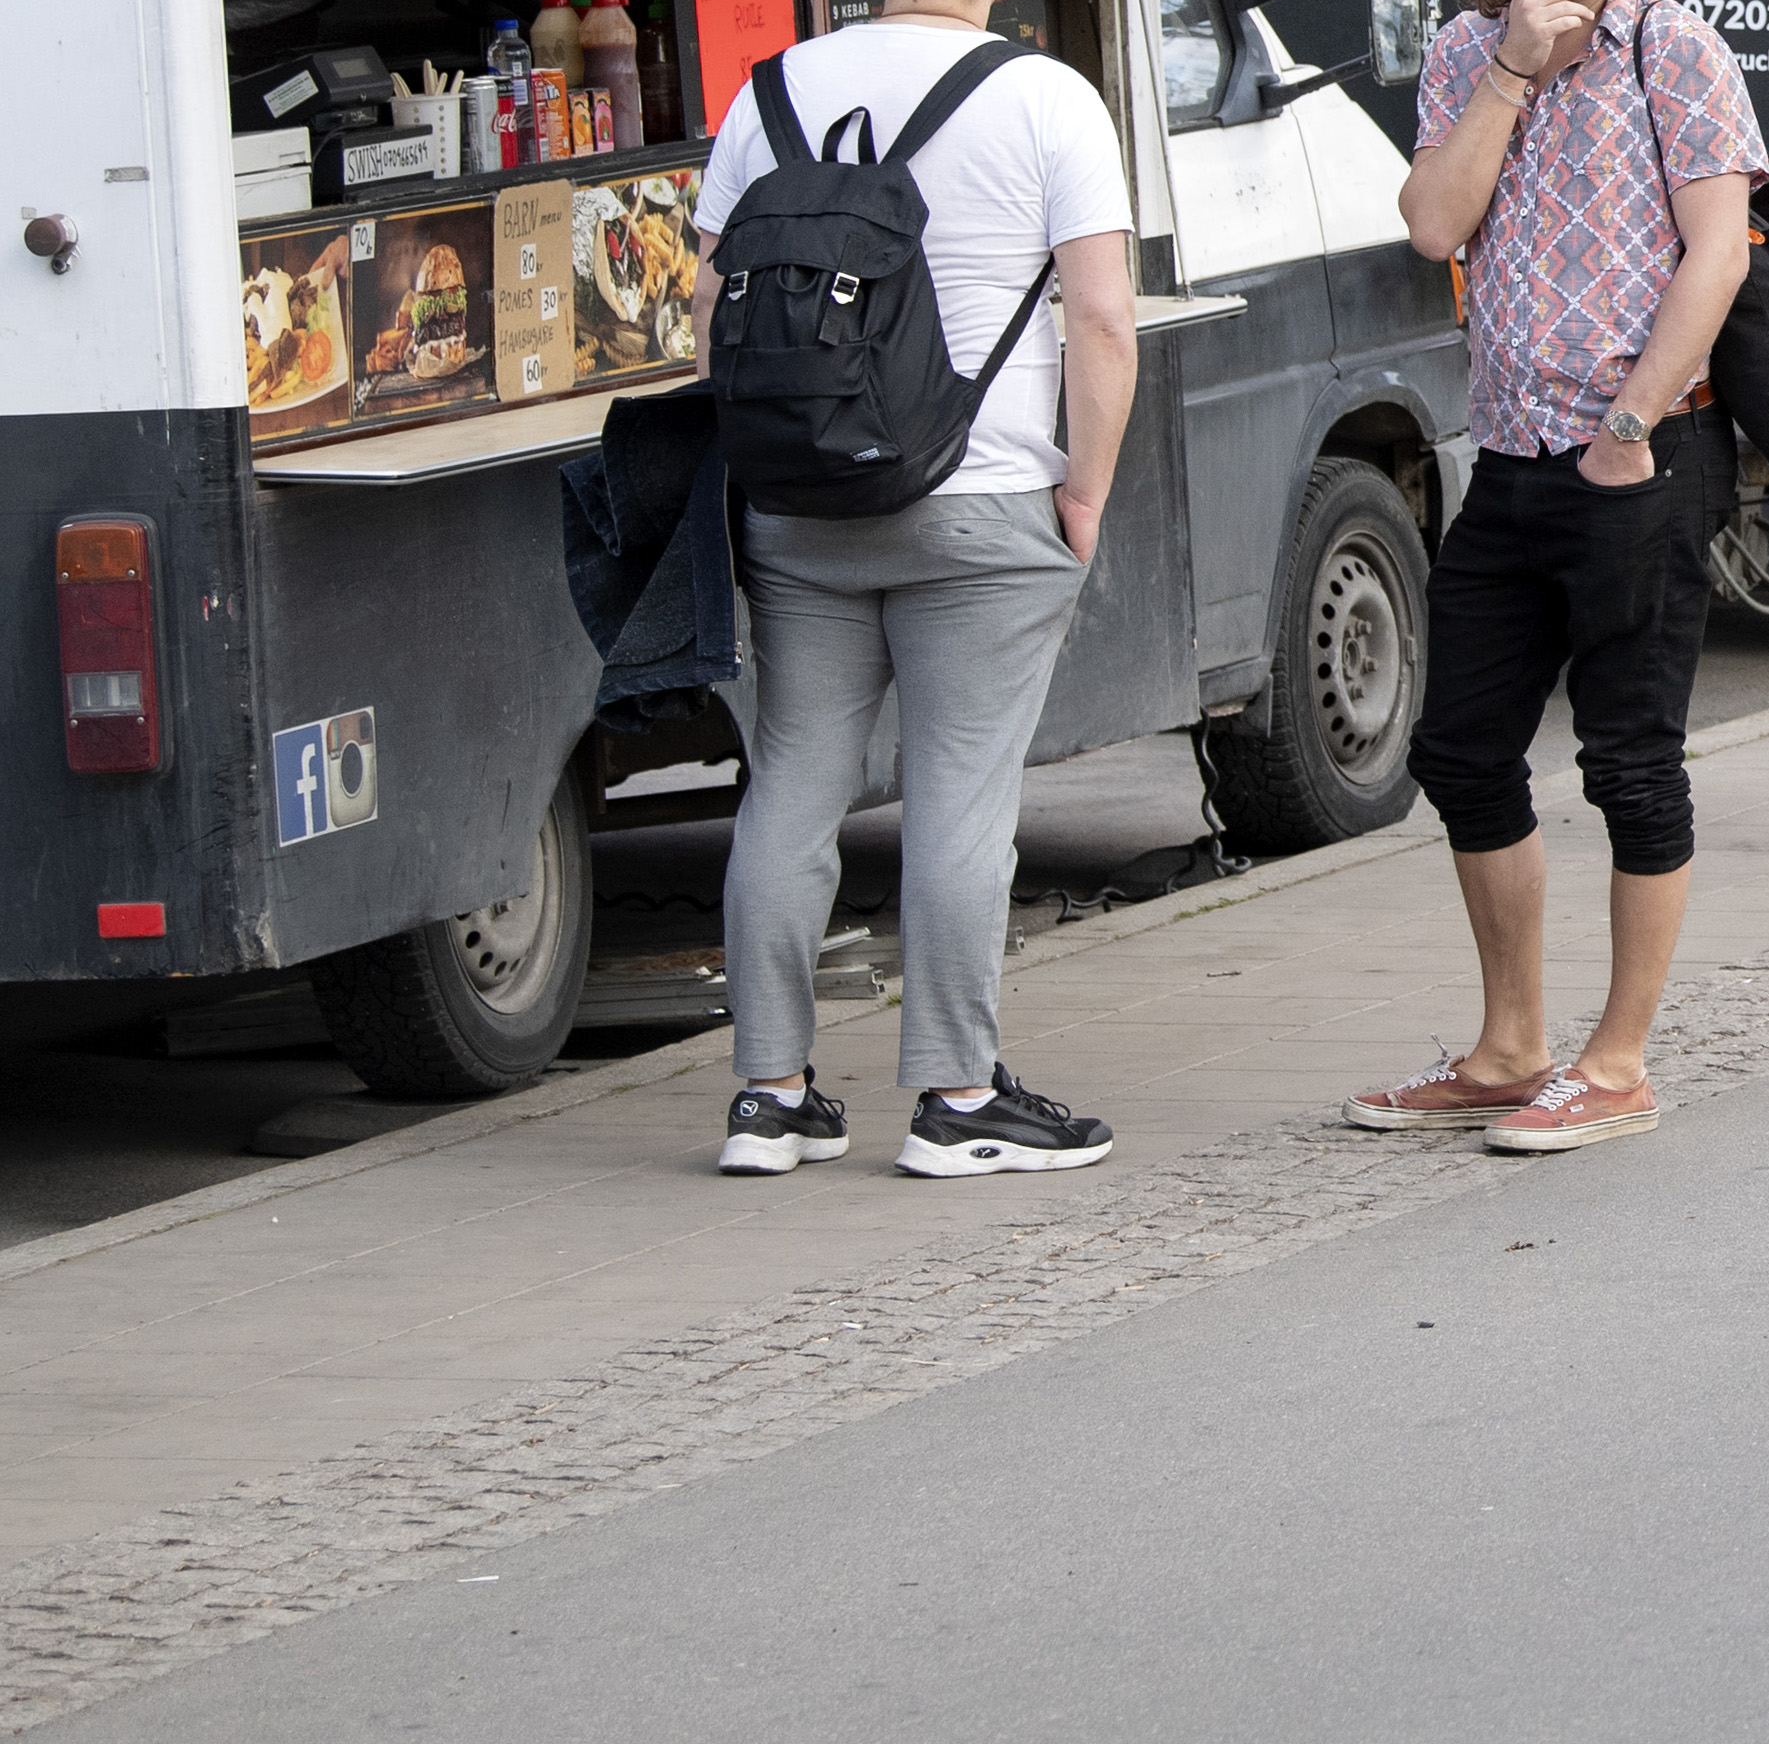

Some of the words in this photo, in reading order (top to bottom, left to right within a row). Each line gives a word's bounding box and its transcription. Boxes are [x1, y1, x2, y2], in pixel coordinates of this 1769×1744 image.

[841, 2, 869, 17] KEBAB
[347, 144, 384, 183] SWISH
[503, 198, 539, 239] BARN
